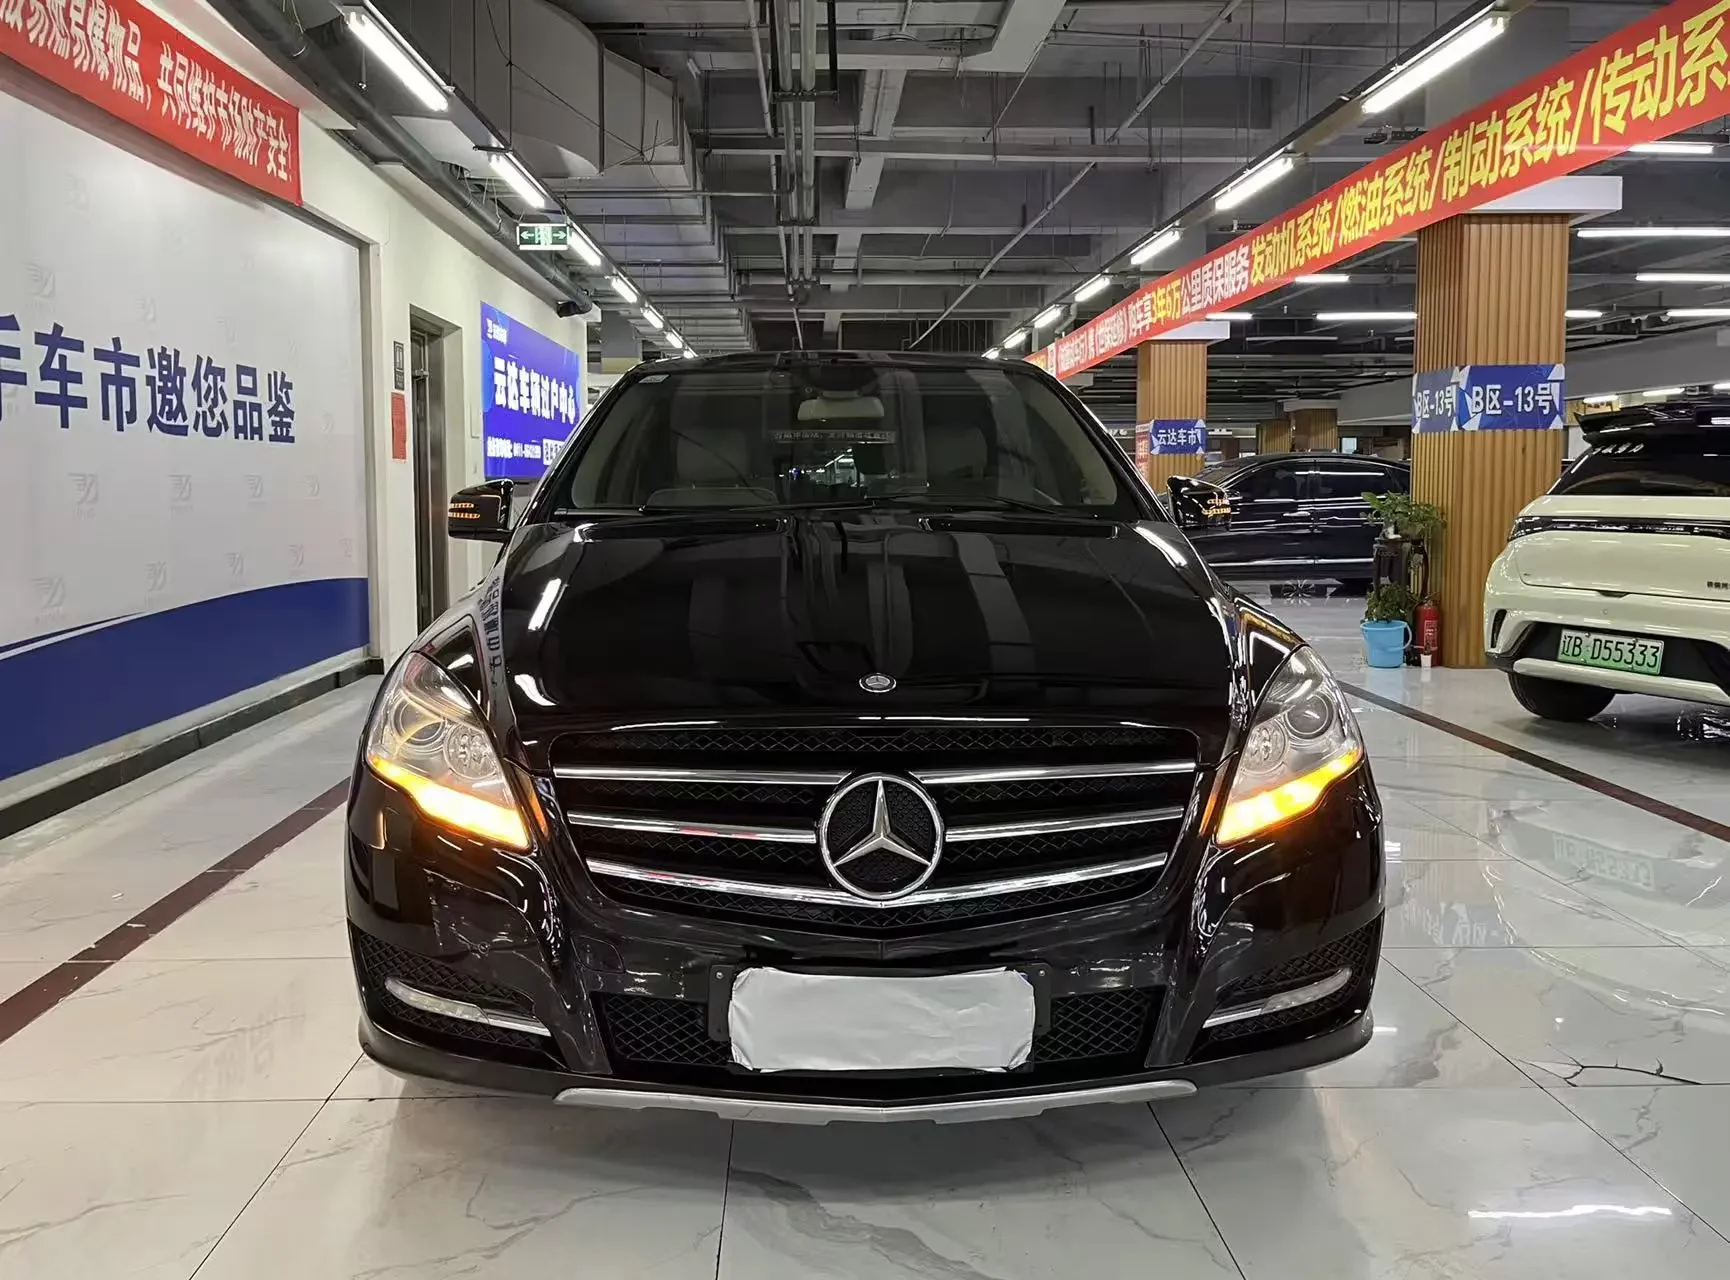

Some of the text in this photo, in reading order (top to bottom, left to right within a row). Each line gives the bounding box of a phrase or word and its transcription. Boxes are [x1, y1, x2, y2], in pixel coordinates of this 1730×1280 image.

[1251, 0, 1730, 288] 发动机系统/燃油系统/制动系统/传动系
[1415, 385, 1455, 419] B区-13号
[1472, 383, 1553, 415] B区-13号
[1157, 428, 1197, 446] 云达车市
[1590, 638, 1660, 668] D55333
